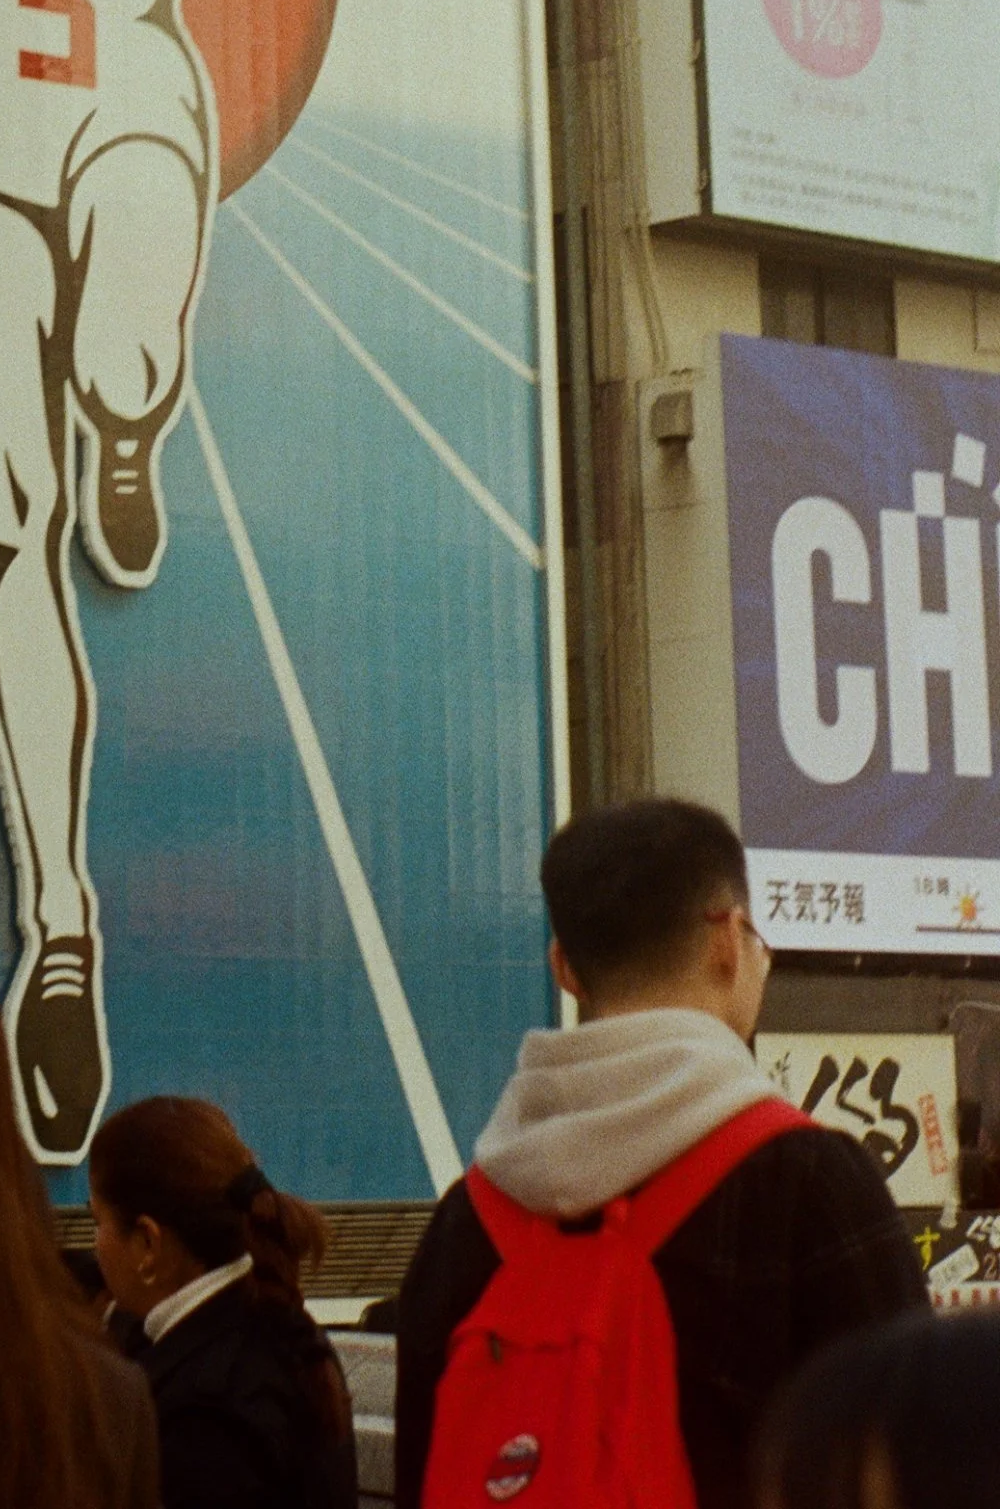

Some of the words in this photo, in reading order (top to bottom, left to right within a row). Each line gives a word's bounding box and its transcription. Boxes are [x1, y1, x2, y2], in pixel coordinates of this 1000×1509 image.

[771, 495, 1000, 785] CH
[765, 879, 866, 925] 天気予報
